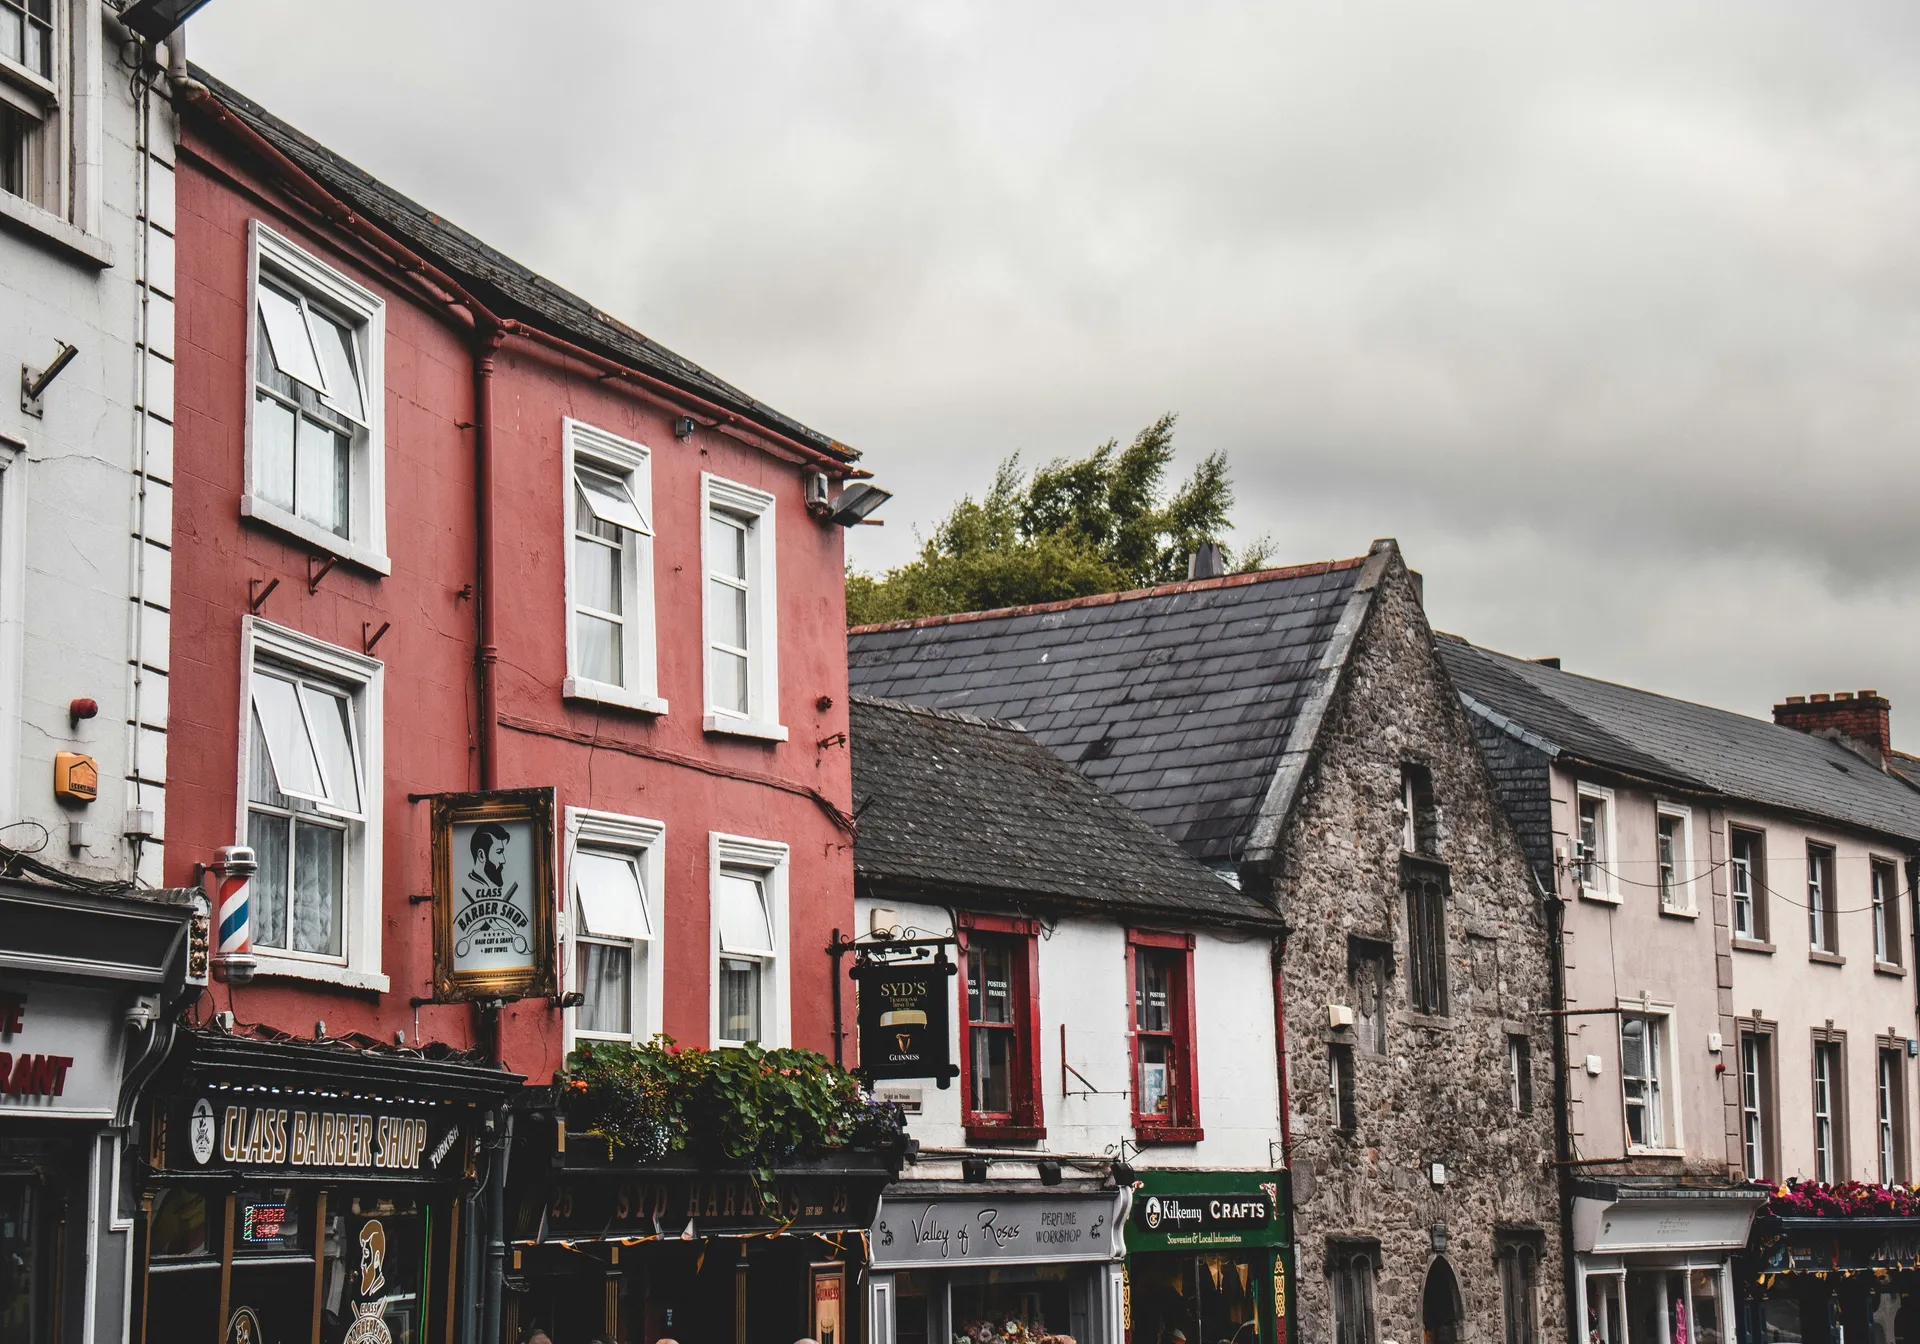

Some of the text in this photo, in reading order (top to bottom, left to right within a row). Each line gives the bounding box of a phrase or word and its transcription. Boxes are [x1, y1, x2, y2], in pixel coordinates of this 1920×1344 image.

[475, 888, 502, 898] CLASS
[457, 902, 499, 932] BARBER
[500, 904, 528, 928] SHOP
[880, 981, 927, 997] SYD'S
[987, 980, 1007, 988] POSTERS
[988, 989, 1007, 997] FRAMES
[888, 1053, 920, 1062] GUINNESS
[223, 1105, 288, 1164] CLASS
[291, 1110, 373, 1167] BARBER
[375, 1115, 427, 1170] SHOP
[428, 1123, 460, 1170] TURKISH
[551, 1185, 572, 1218] 25
[616, 1184, 668, 1219] SYD
[832, 1183, 848, 1213] 25
[252, 1208, 285, 1223] BARBER
[1041, 1211, 1077, 1227] PERFUME
[1162, 1200, 1202, 1229] Kilkenny
[1209, 1200, 1265, 1220] CRAFTS
[256, 1223, 280, 1238] SHOP
[912, 1203, 1020, 1258] Valley of Roses
[1035, 1228, 1082, 1244] WORKSHOP
[1167, 1232, 1192, 1244] Souvenirs
[1199, 1231, 1213, 1244] Local
[1213, 1231, 1242, 1243] Information
[816, 1284, 839, 1302] GUINNESS
[360, 1302, 377, 1314] CLASS
